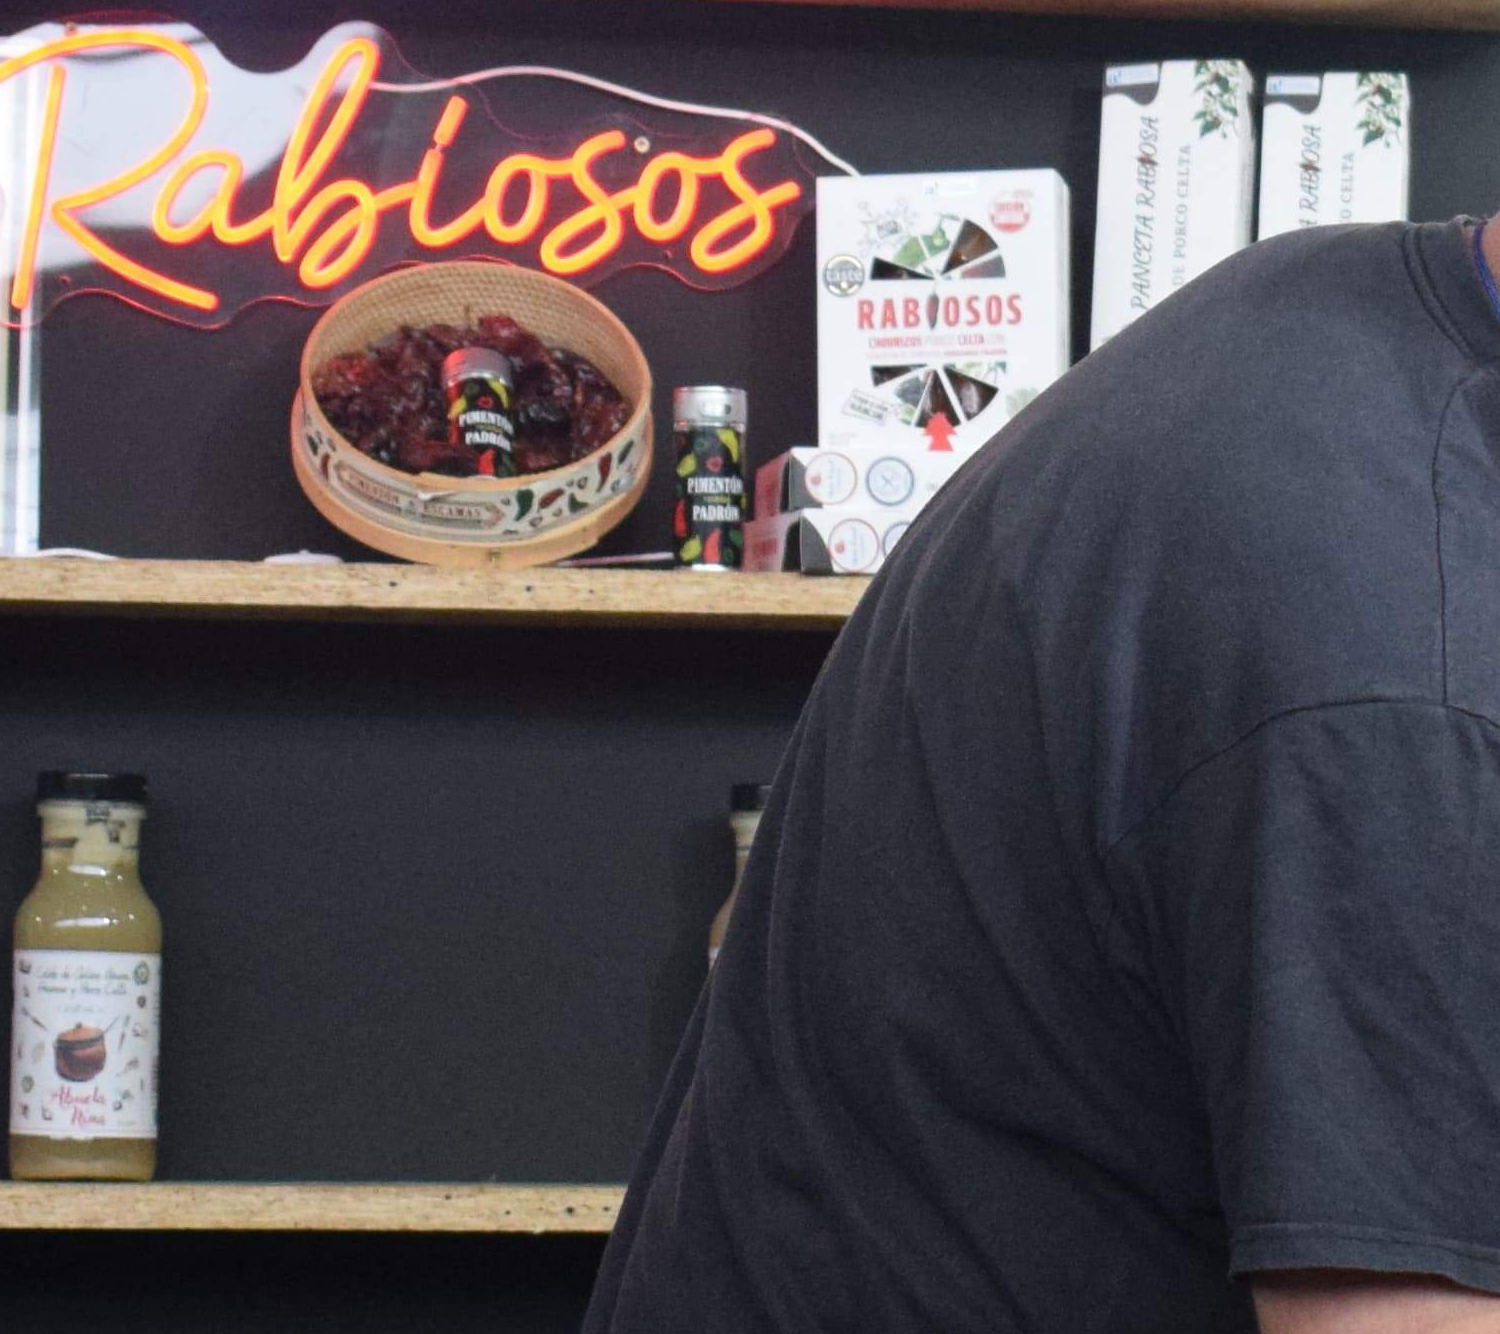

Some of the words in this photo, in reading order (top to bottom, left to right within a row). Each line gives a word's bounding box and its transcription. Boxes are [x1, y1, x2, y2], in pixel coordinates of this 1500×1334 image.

[1175, 144, 1191, 198] CELTA
[1340, 152, 1355, 203] CELTA
[1173, 202, 1189, 259] PORCO
[1130, 215, 1155, 310] PANCETA
[857, 293, 1023, 330] RABIOSOS
[686, 476, 744, 494] PIMENTÓN
[692, 504, 741, 522] PADRÓN
